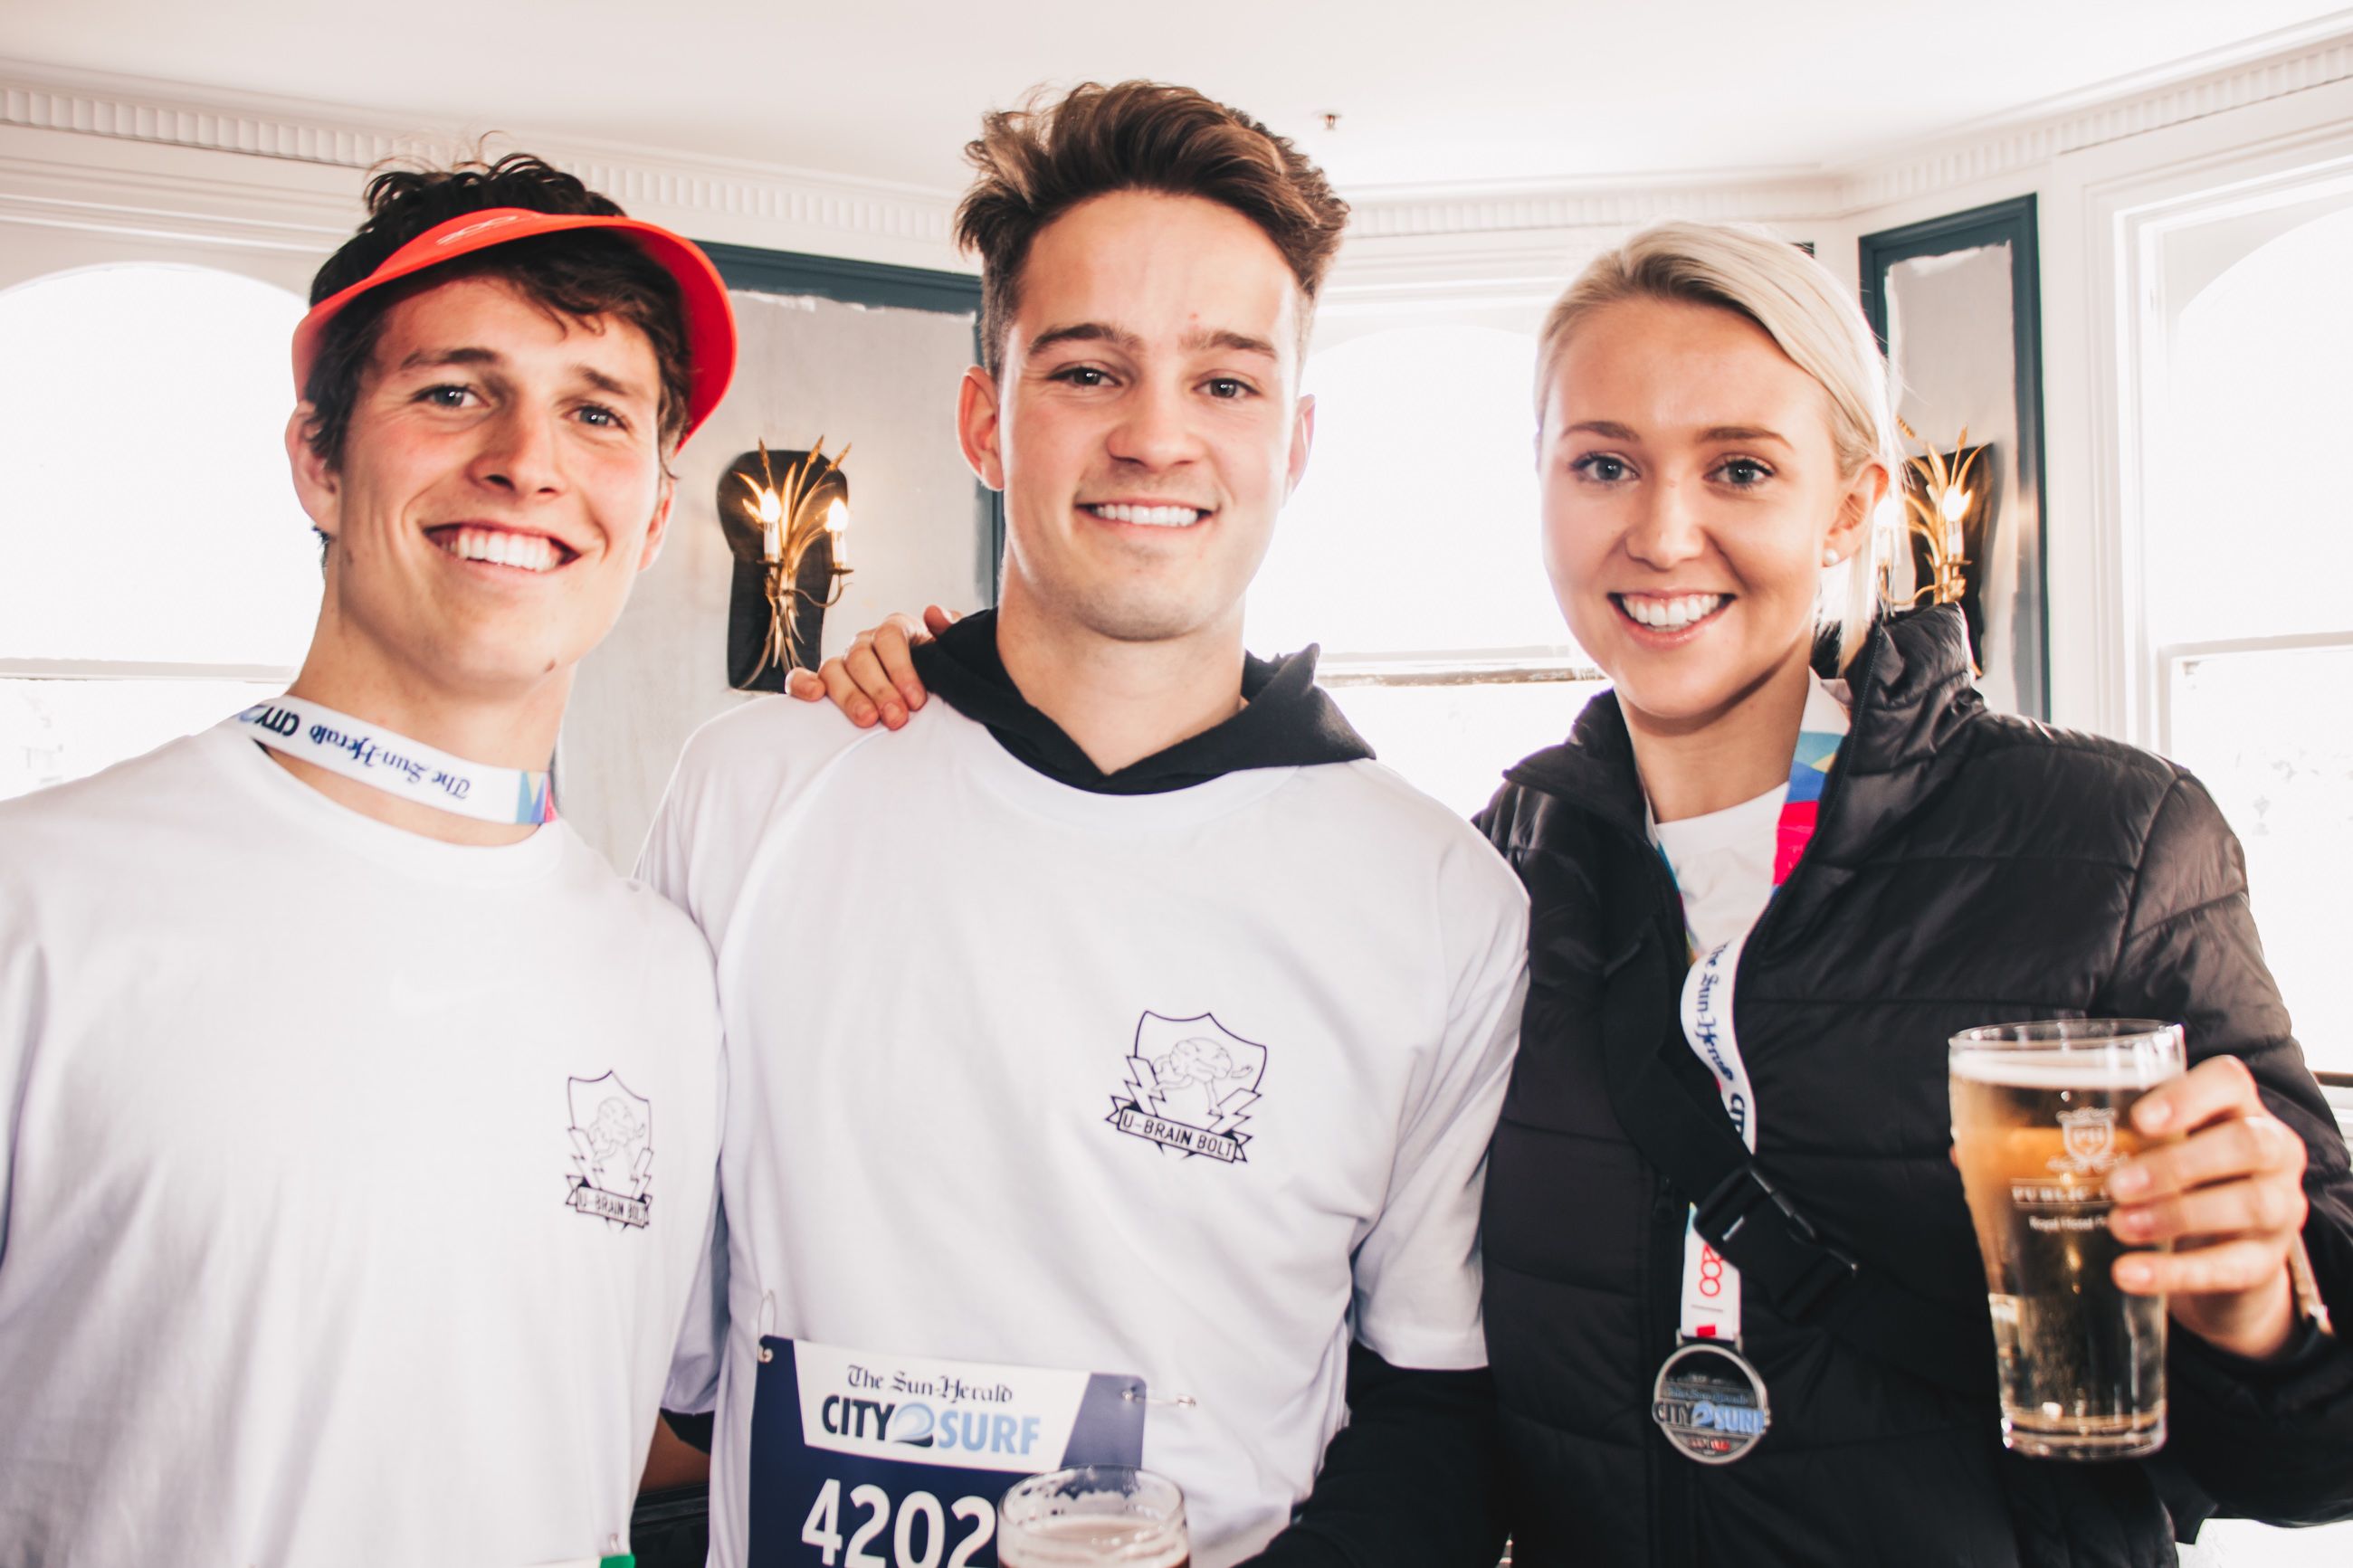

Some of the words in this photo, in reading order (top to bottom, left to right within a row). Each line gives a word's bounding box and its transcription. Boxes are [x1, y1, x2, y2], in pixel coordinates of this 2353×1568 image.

[309, 724, 429, 786] Sun-Herald
[431, 772, 471, 800] The
[1122, 1114, 1193, 1145] U-BRAIN
[1196, 1134, 1234, 1157] BOLT
[579, 1192, 624, 1216] U-BRAIN
[848, 1364, 884, 1391] The
[891, 1370, 1014, 1404] Sun-Herald
